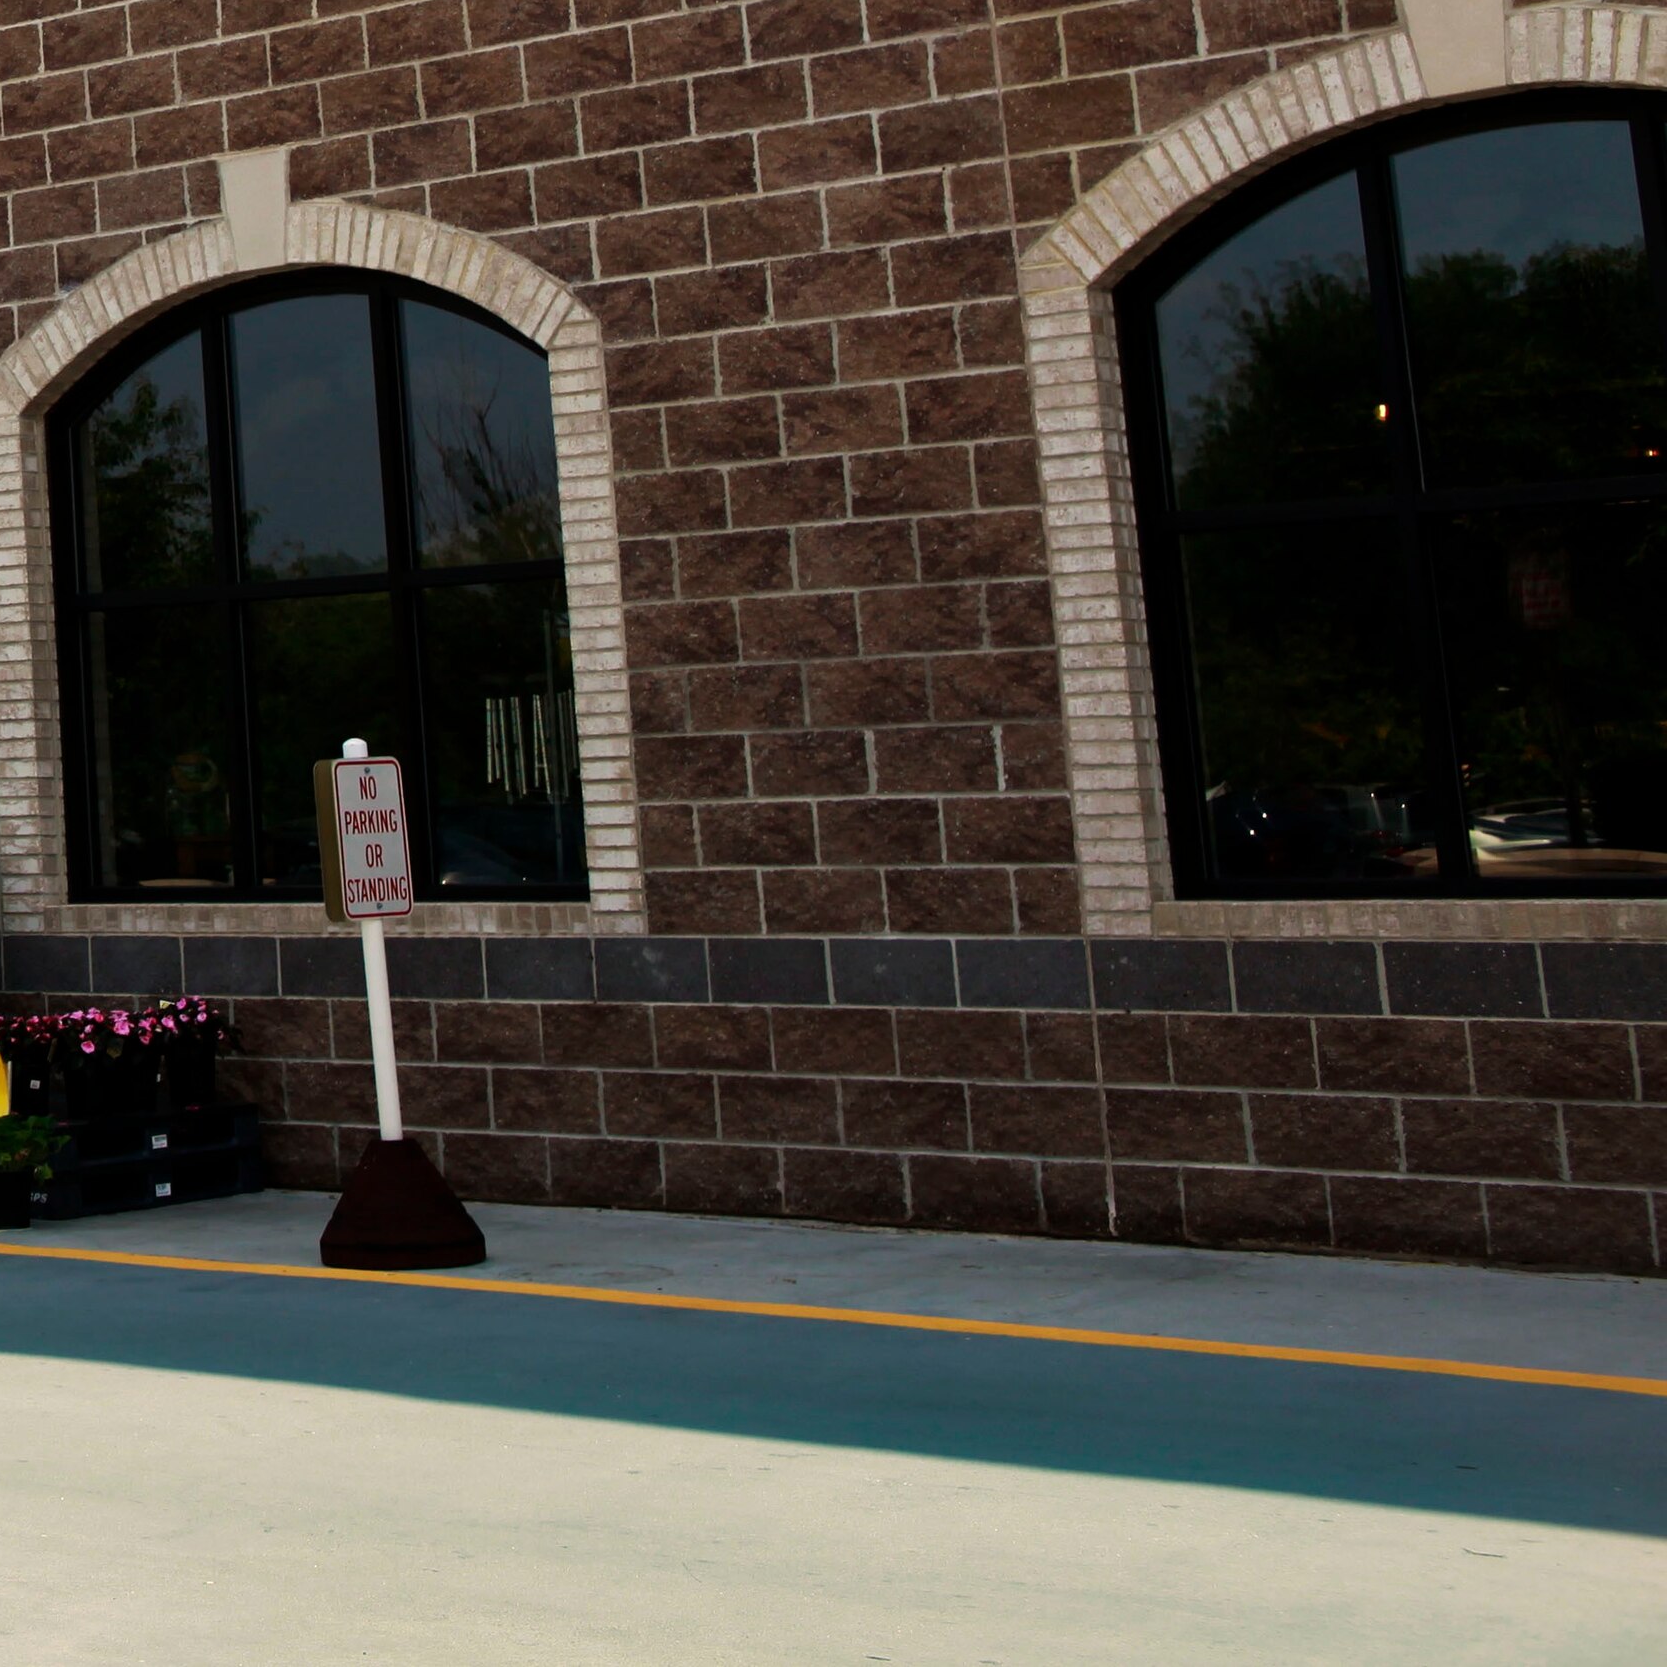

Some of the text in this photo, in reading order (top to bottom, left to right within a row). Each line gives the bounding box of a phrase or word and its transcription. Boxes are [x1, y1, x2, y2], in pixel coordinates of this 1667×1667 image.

[359, 775, 377, 800] NO
[344, 809, 398, 835] PARKING
[365, 843, 383, 868] OR
[347, 876, 408, 904] STANDING
